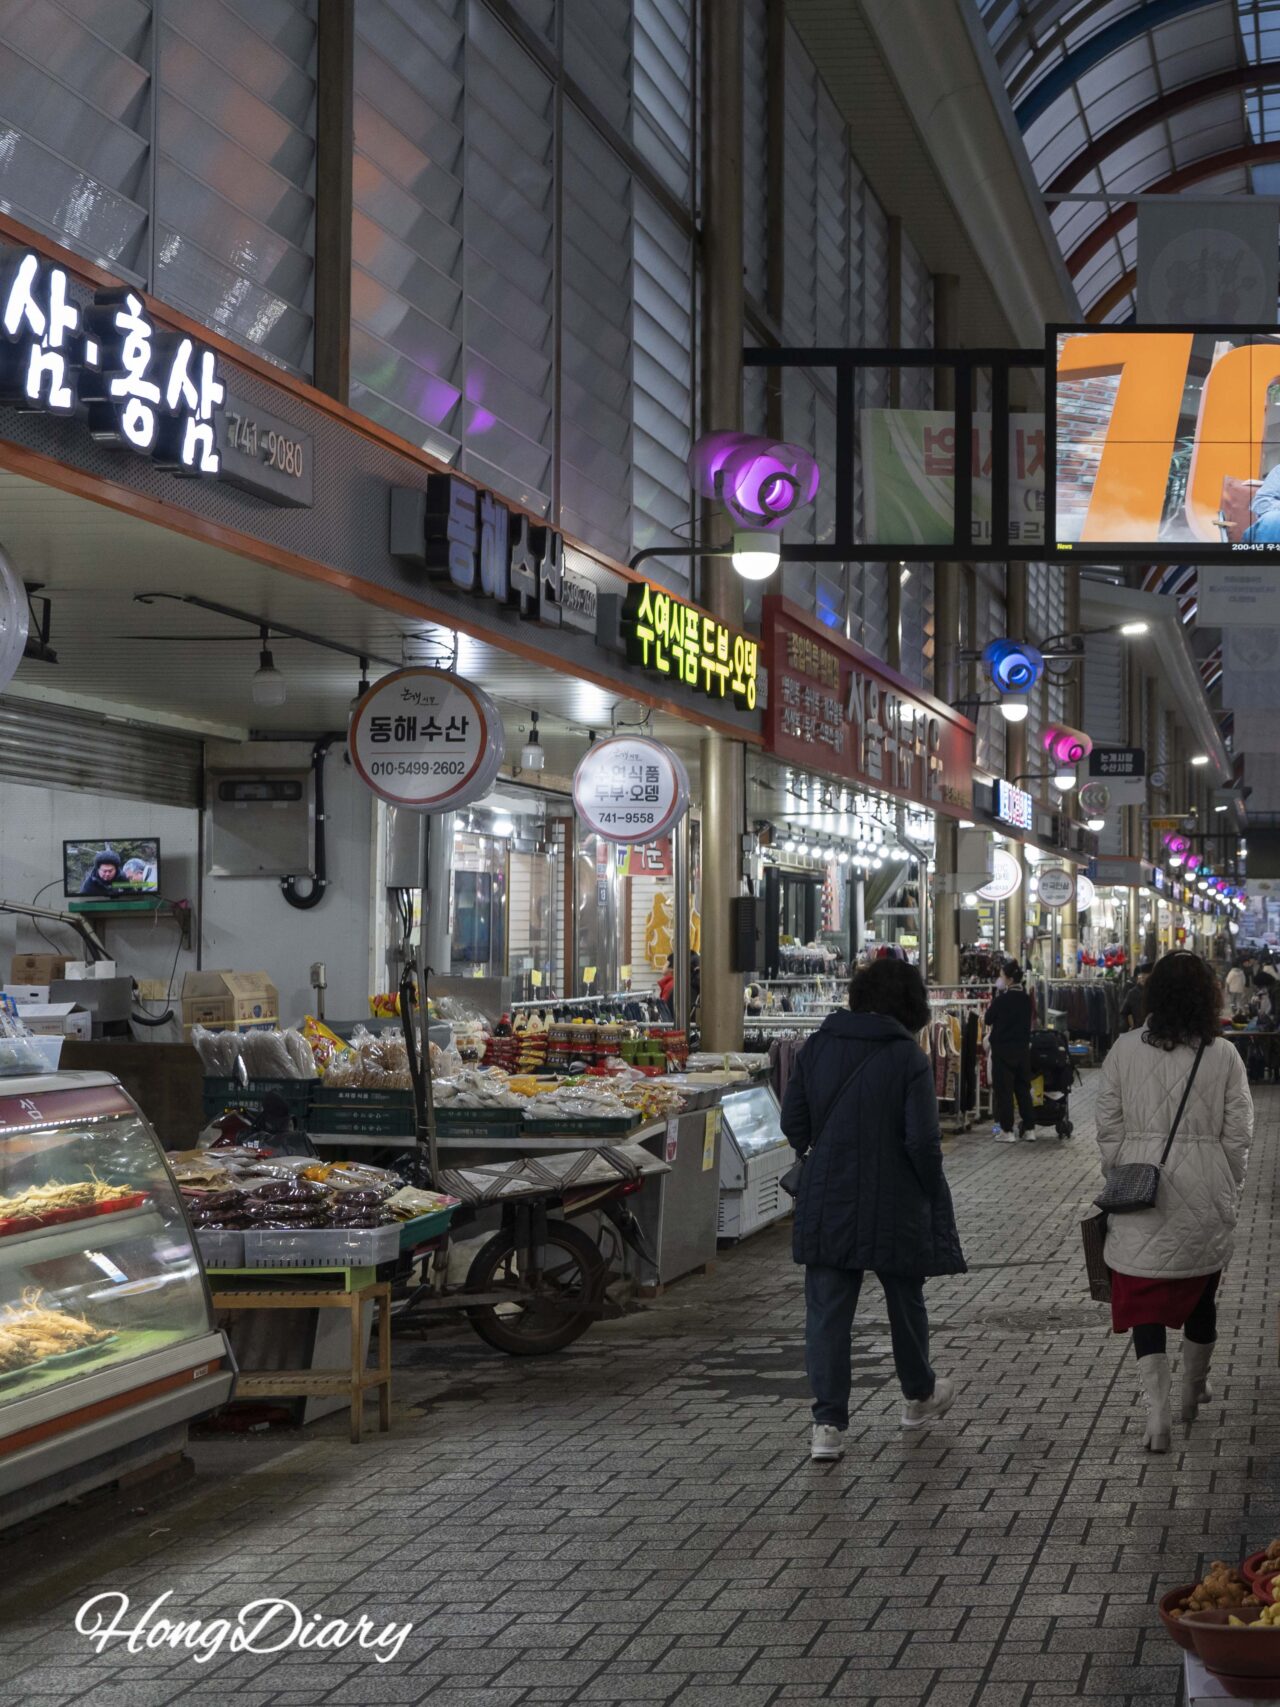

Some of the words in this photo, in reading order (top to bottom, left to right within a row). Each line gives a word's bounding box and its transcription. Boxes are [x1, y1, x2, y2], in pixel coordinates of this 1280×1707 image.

[226, 411, 303, 478] 741-9080
[1232, 543, 1264, 552] 2004년
[637, 586, 699, 685] 수연식품
[370, 715, 469, 743] 동해수산
[599, 812, 654, 824] 741-9558
